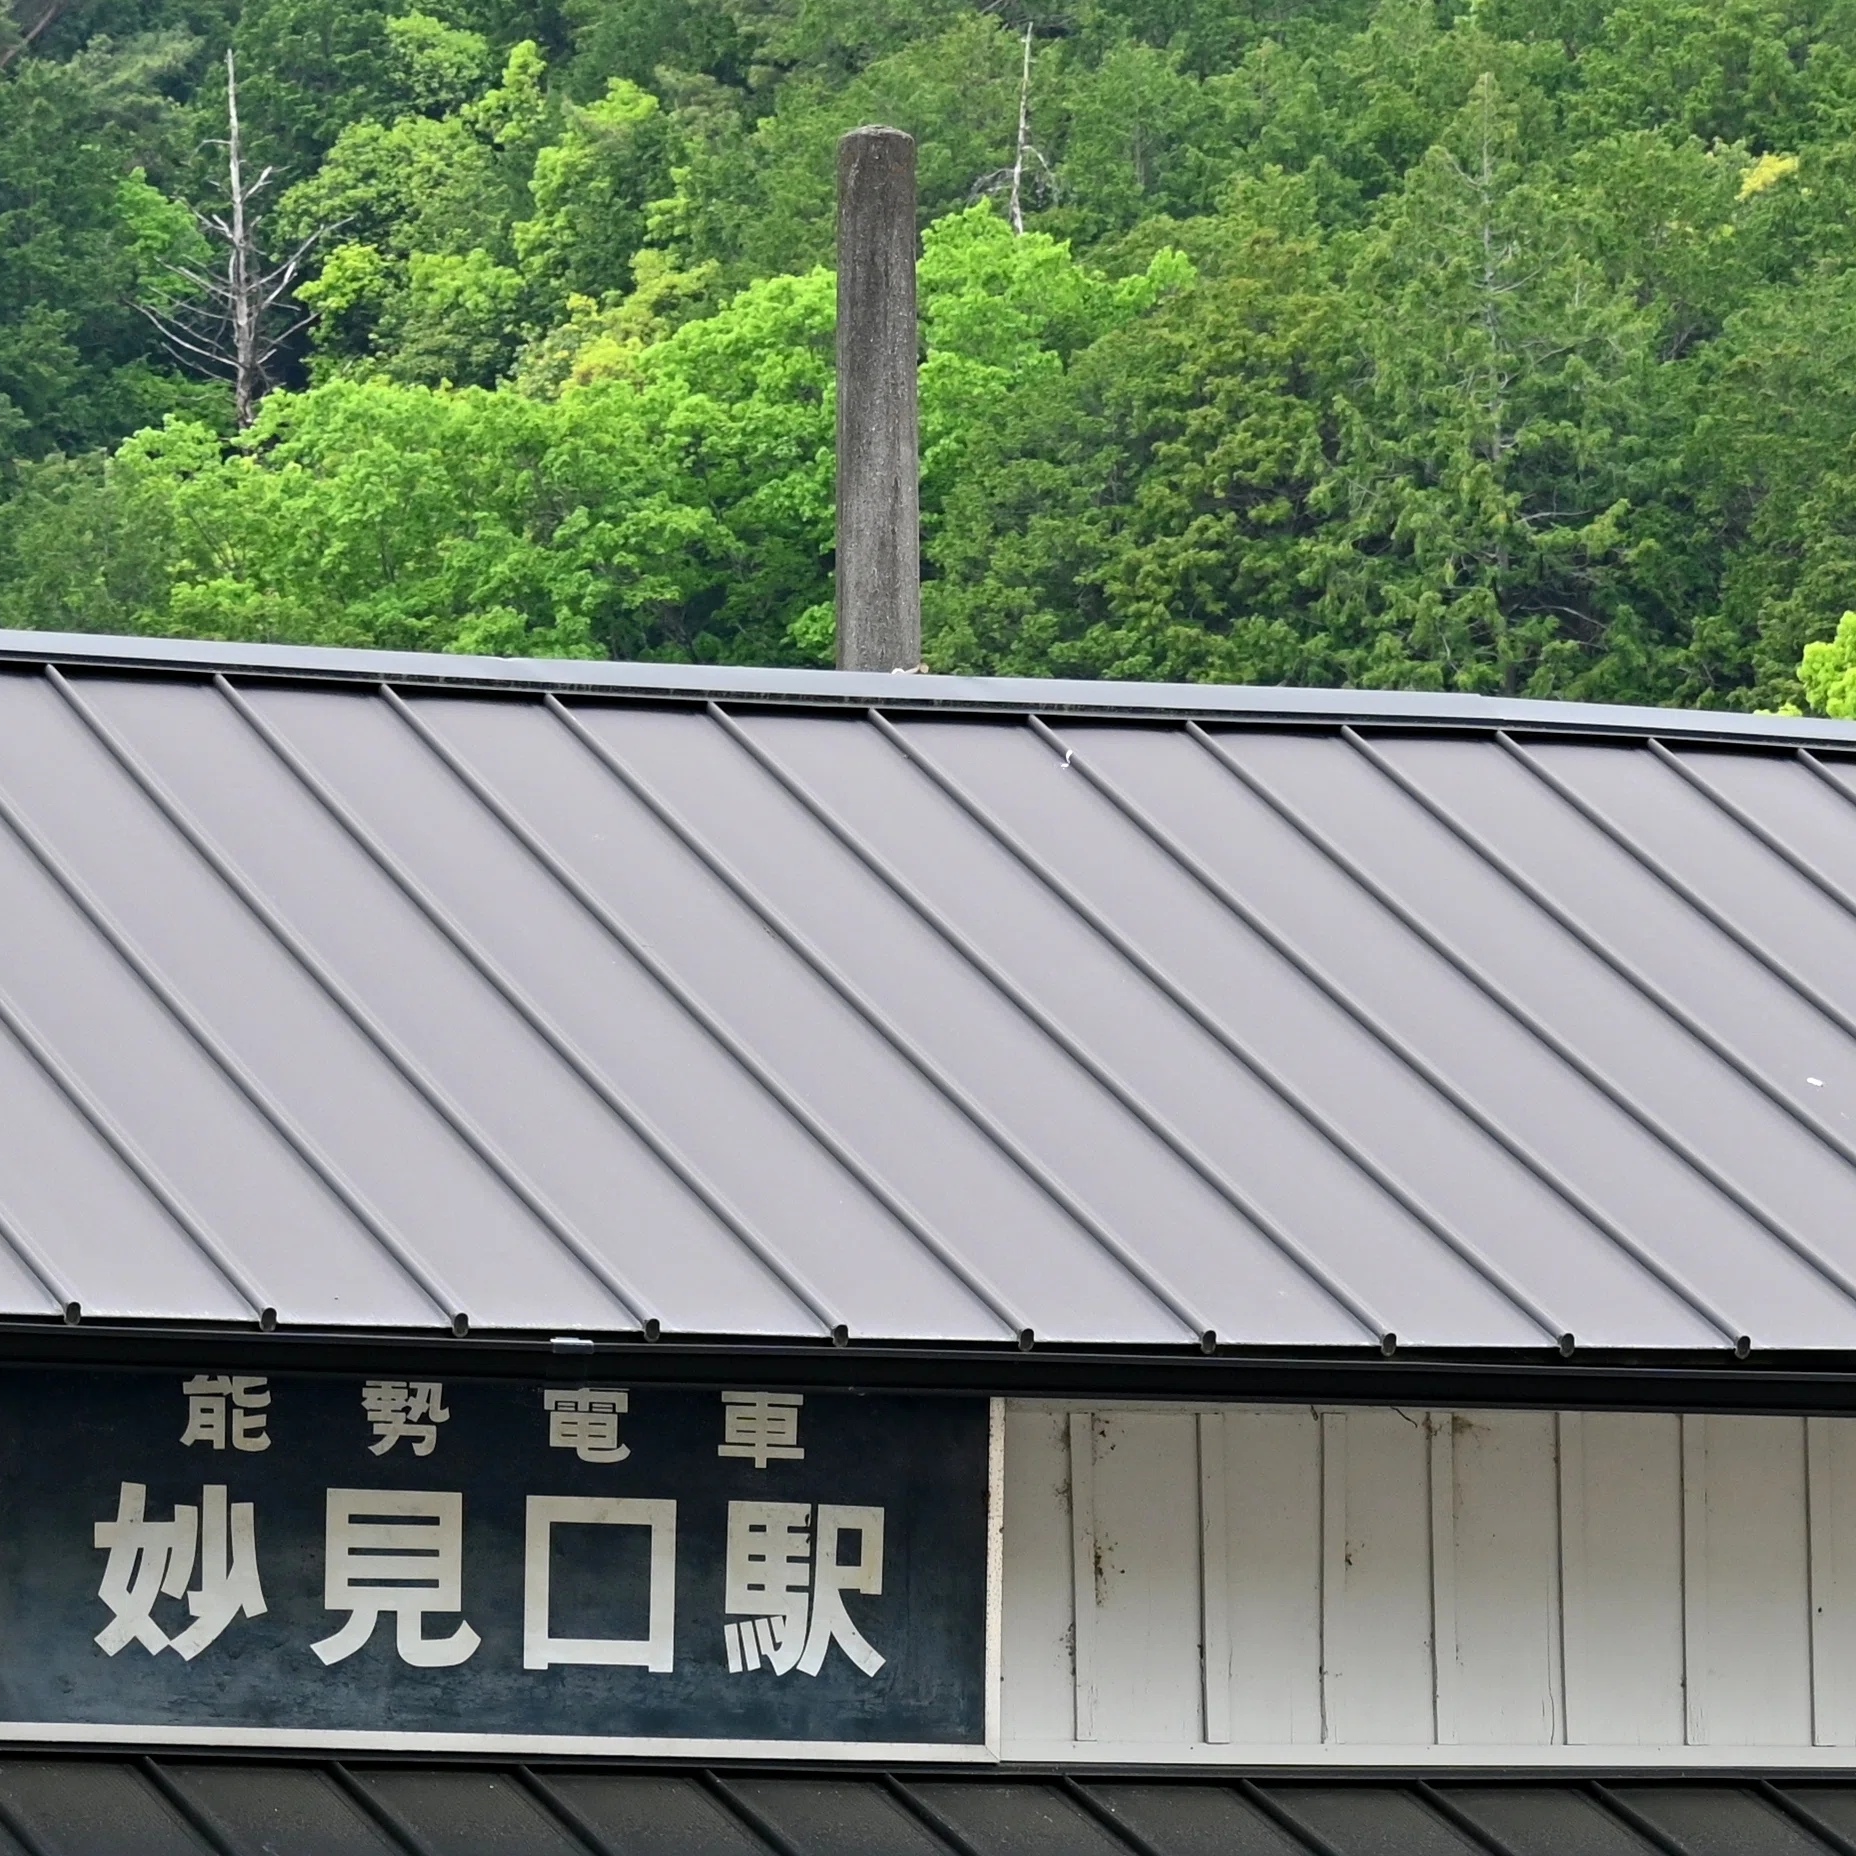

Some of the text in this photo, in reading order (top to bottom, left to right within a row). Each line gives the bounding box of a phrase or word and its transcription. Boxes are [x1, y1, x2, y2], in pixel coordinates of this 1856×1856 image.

[180, 1375, 806, 1469] 能勢電車
[93, 1480, 887, 1679] 妙見口駅
